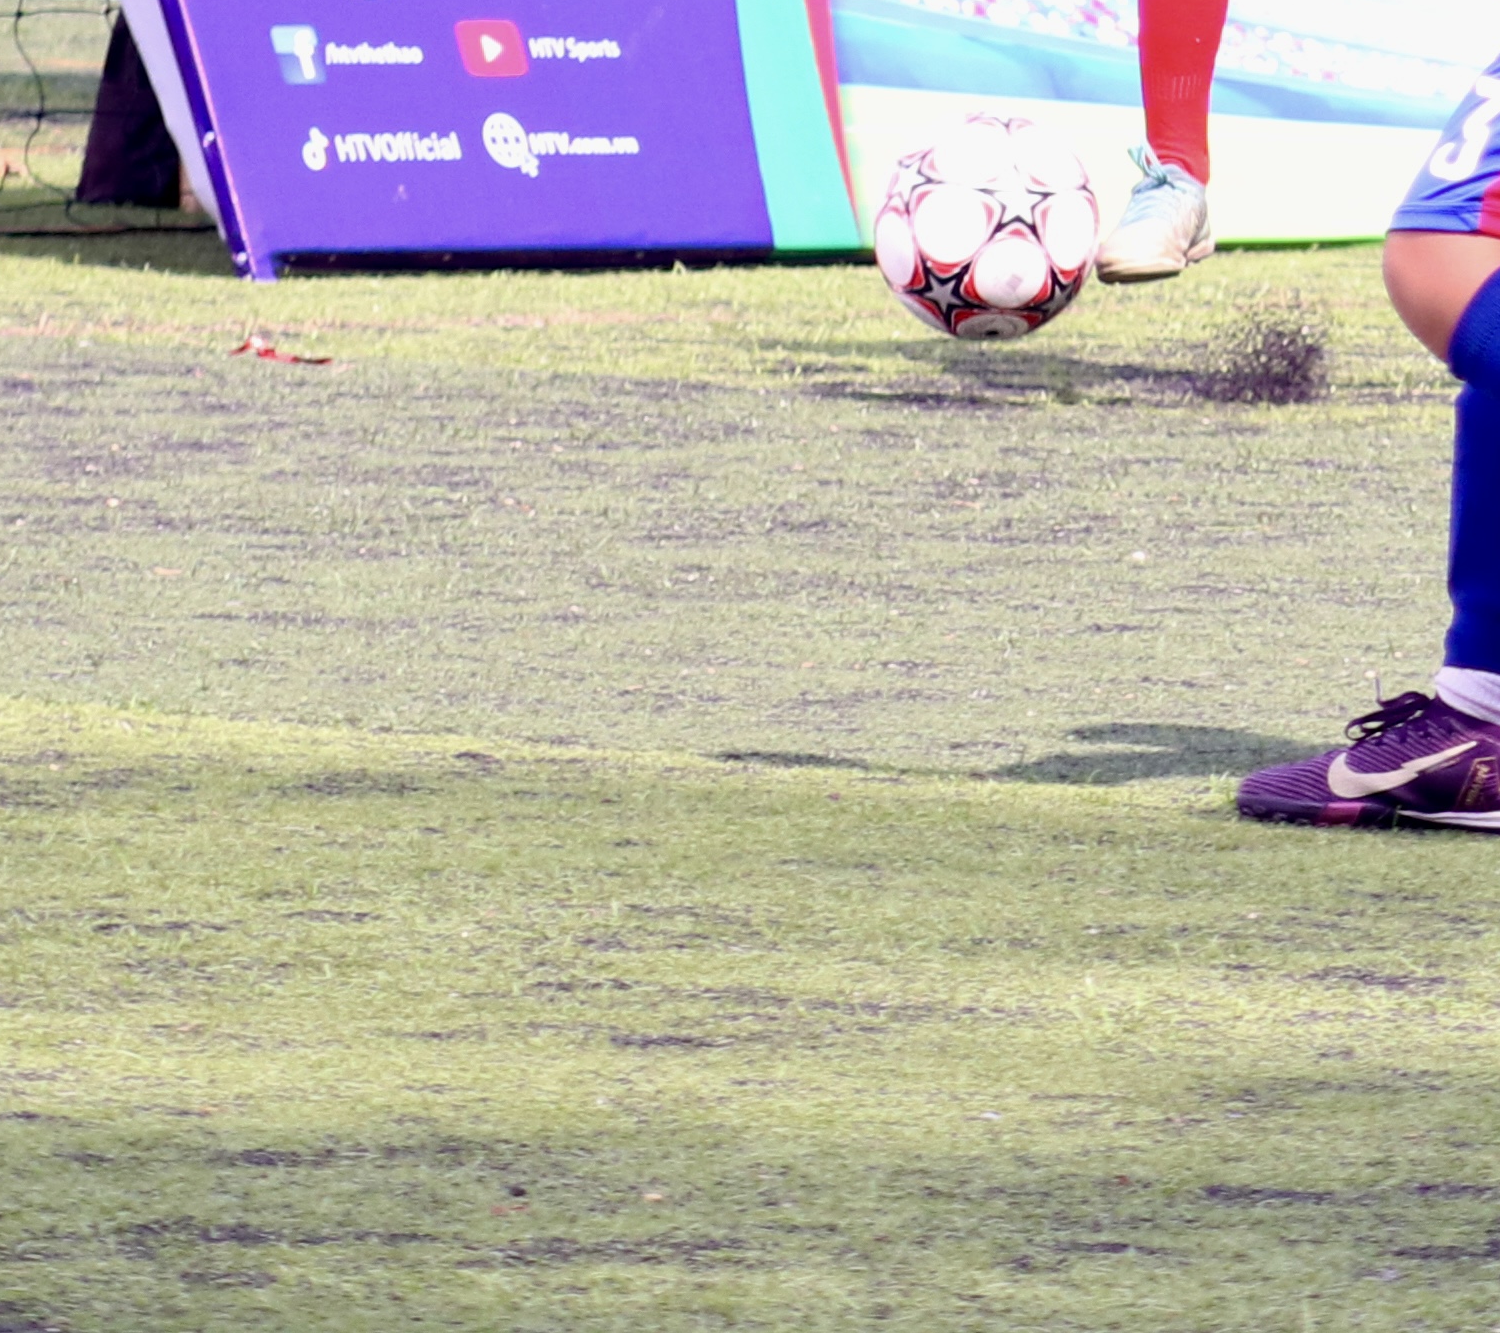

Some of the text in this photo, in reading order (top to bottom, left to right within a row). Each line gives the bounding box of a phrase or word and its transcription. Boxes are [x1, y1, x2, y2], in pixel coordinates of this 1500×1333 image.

[528, 36, 622, 63] HTV Sports
[334, 131, 462, 162] HTVOfficial
